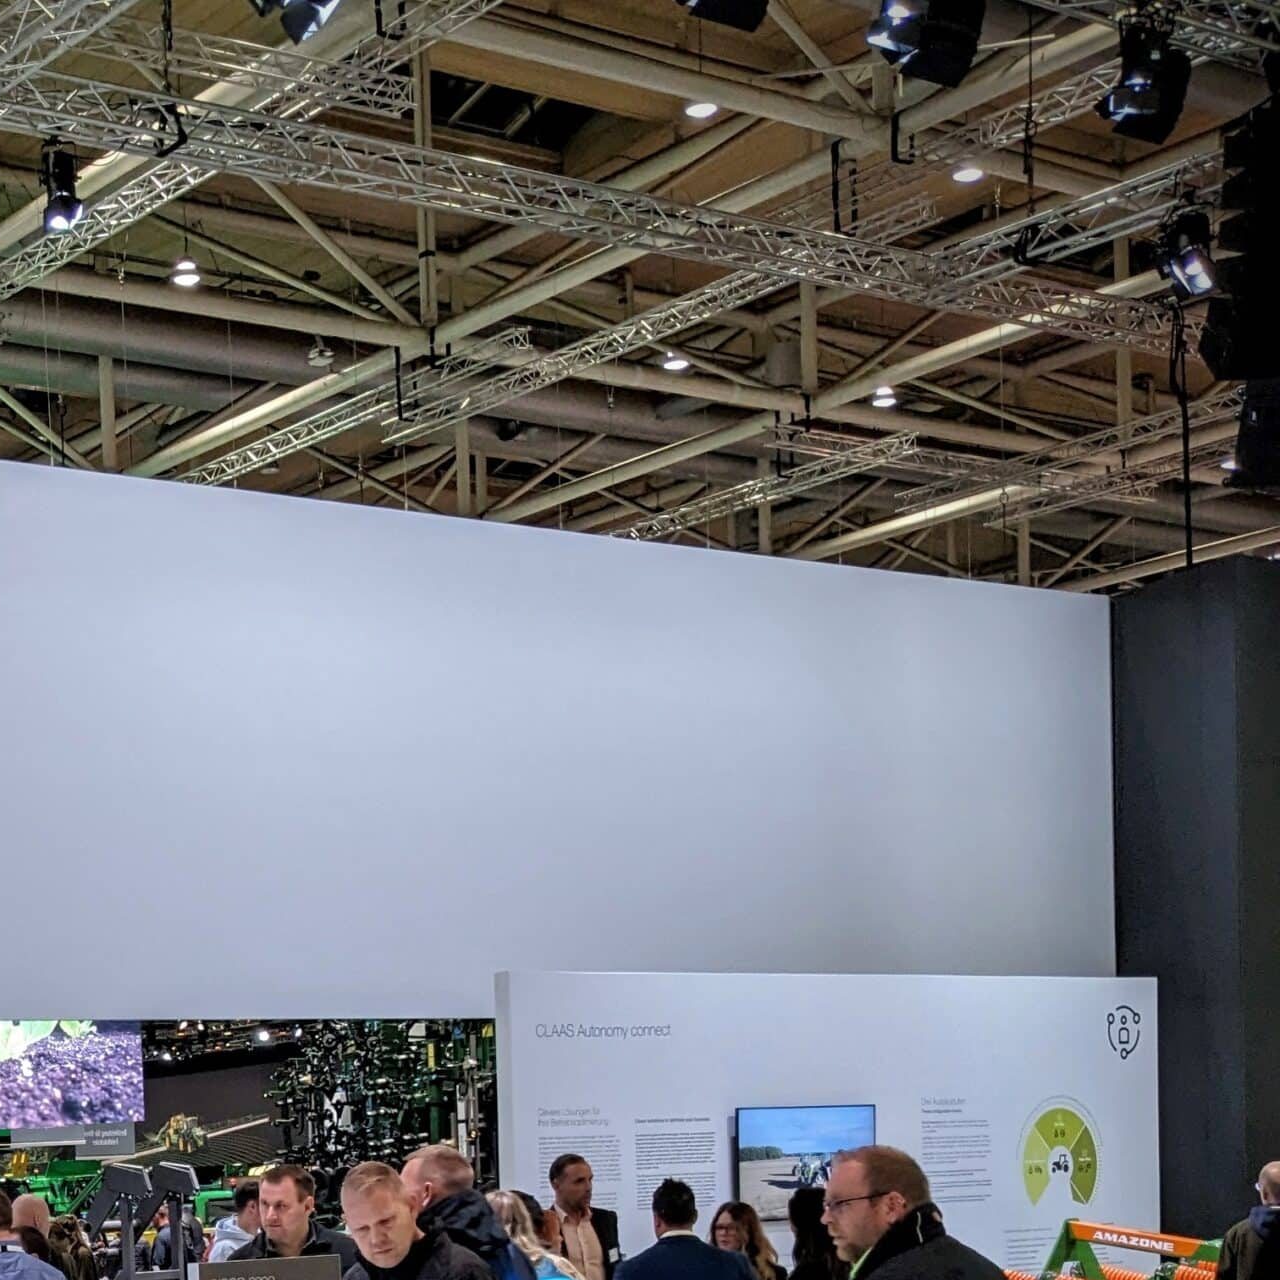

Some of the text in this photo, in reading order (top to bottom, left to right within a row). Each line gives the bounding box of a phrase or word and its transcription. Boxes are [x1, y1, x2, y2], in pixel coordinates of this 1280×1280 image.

[535, 1023, 672, 1040] CLAAS Autonomy connect
[1092, 1230, 1175, 1252] AMAZONE
